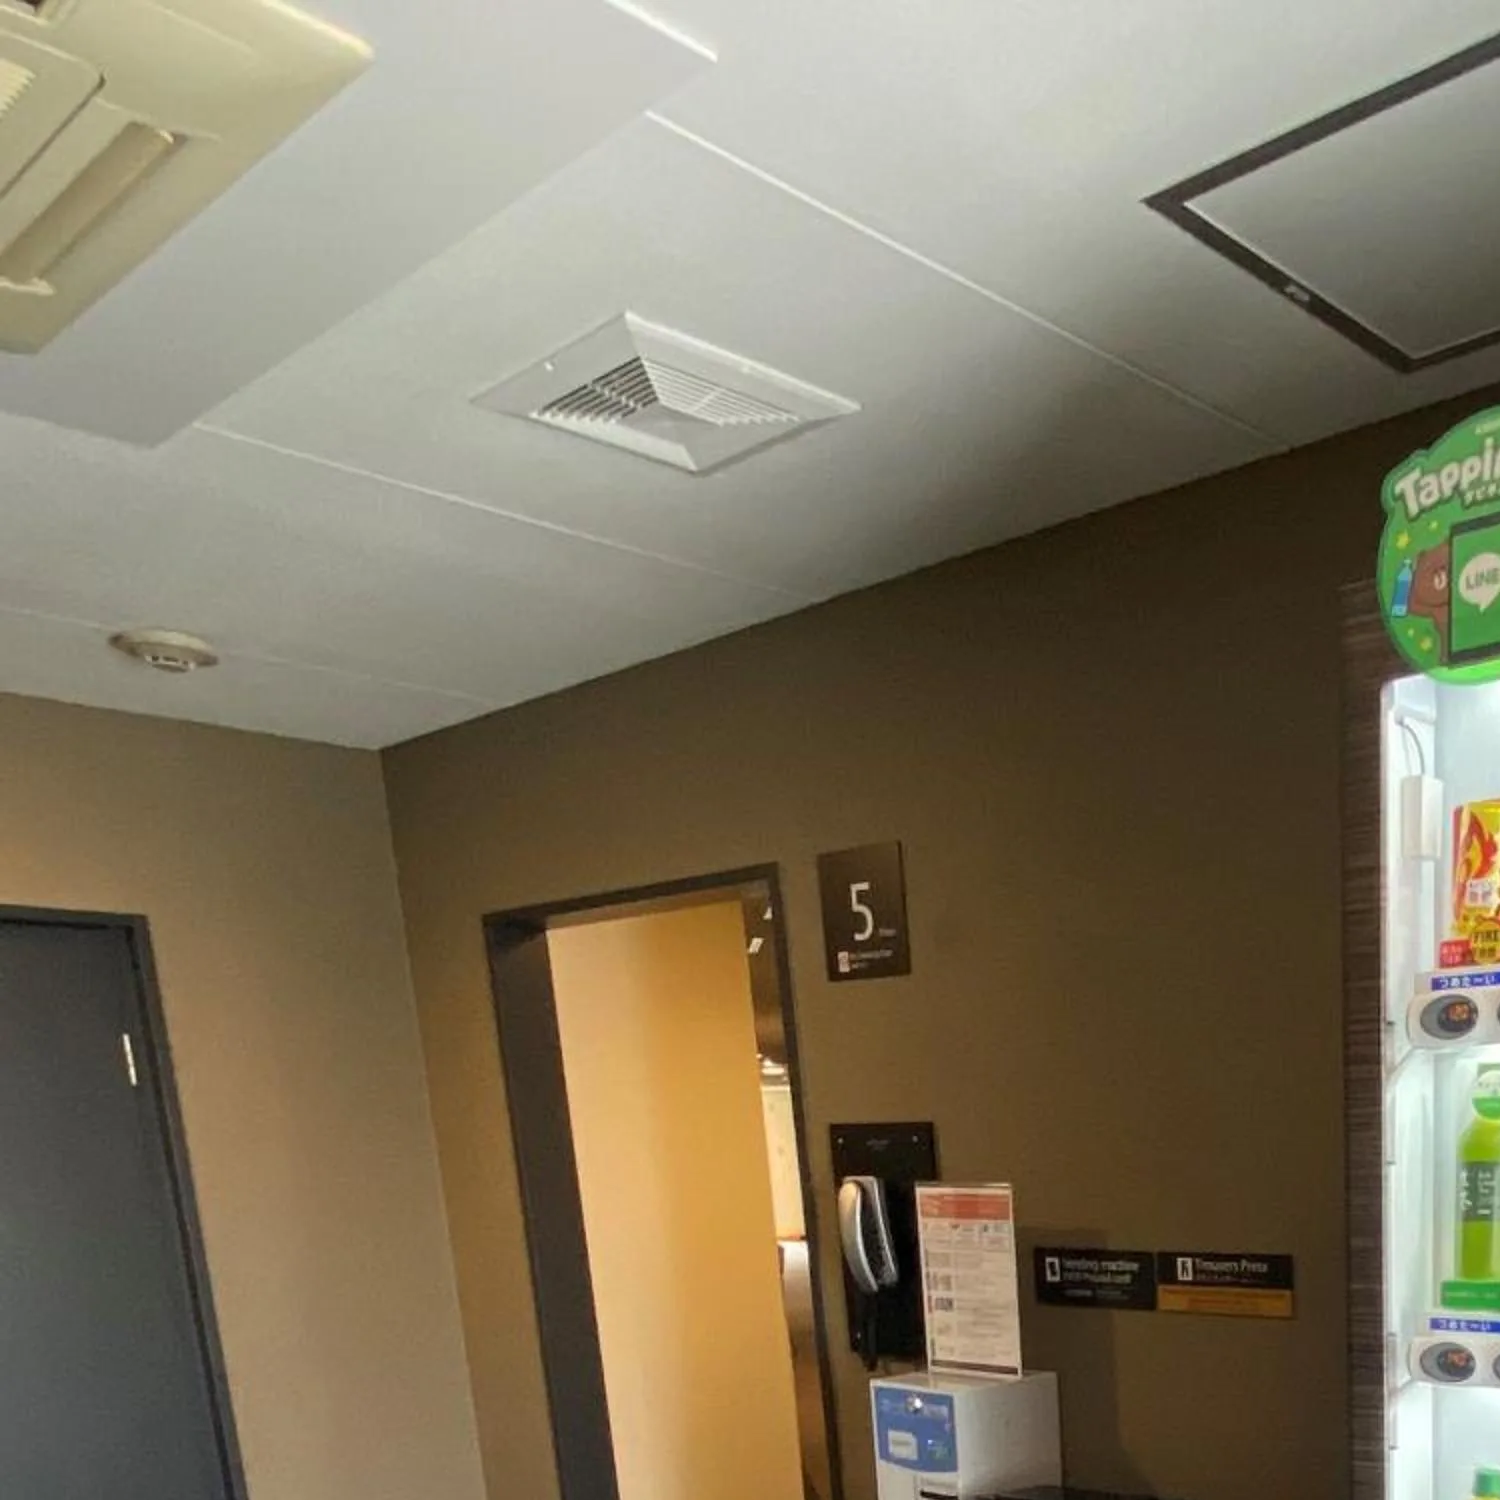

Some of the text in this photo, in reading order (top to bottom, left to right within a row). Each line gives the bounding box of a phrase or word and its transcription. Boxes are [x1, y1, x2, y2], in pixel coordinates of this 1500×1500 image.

[1464, 567, 1500, 591] LINE
[849, 881, 874, 941] 5
[1473, 929, 1499, 944] FIRE
